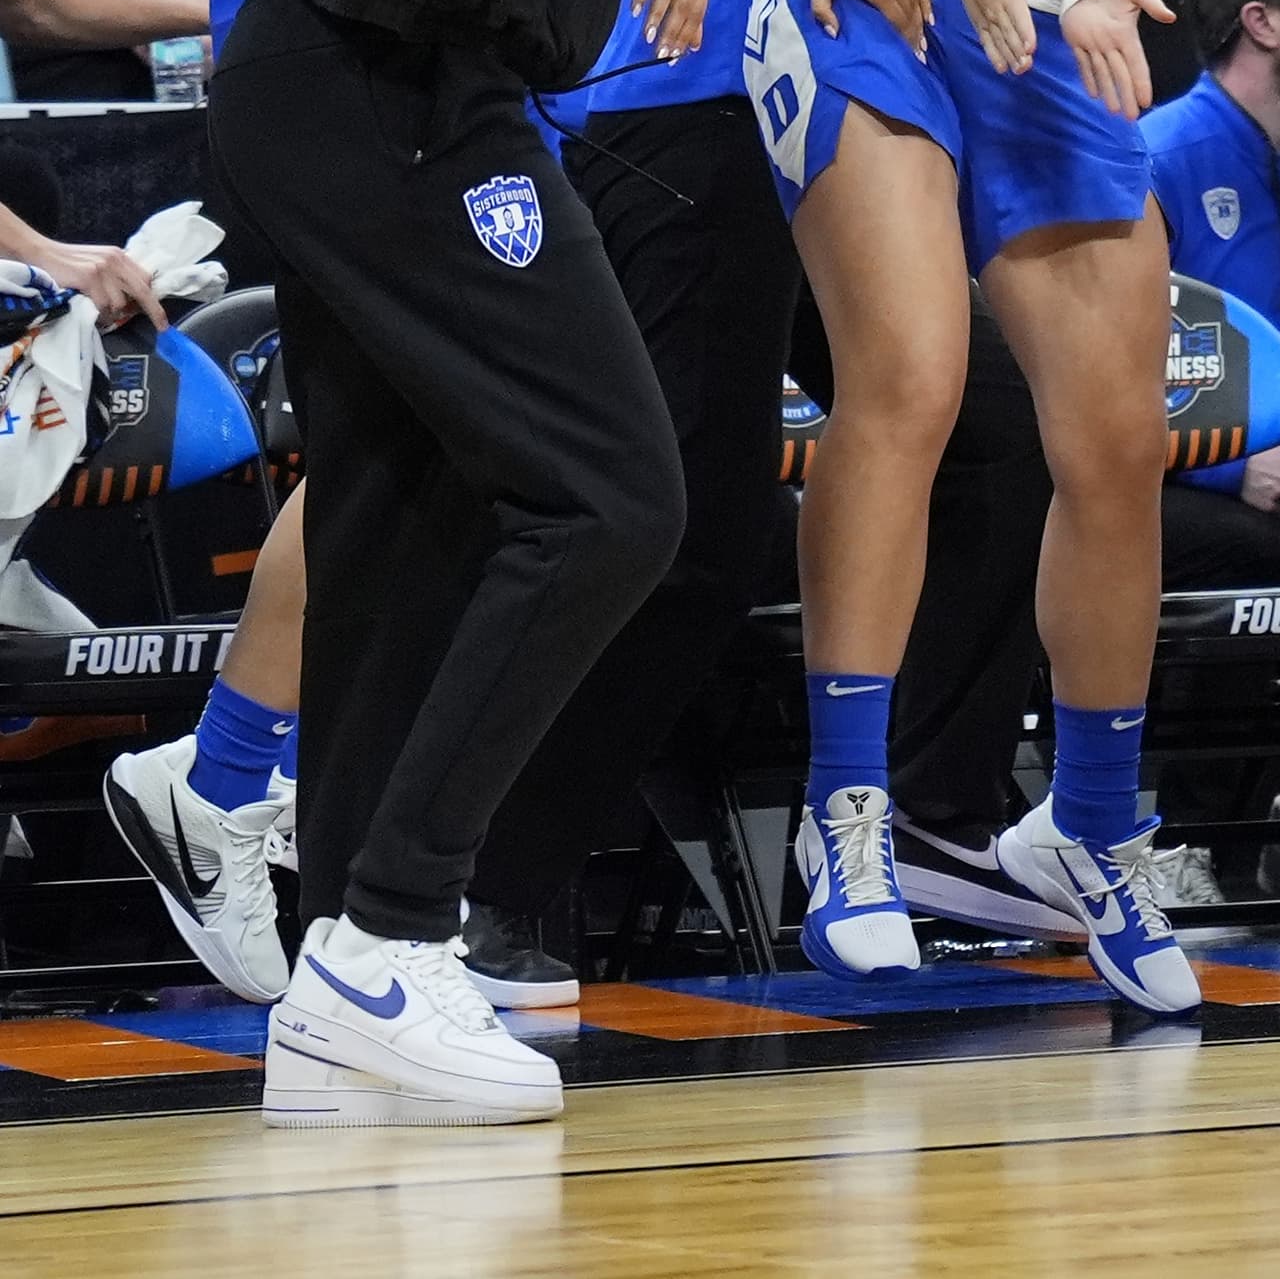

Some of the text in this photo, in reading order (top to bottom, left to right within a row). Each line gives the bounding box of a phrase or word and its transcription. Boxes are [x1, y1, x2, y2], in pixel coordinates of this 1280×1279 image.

[472, 188, 534, 218] SISTERHOOD
[1165, 354, 1221, 381] NESS
[65, 634, 165, 676] FOUR
[172, 632, 209, 673] IT
